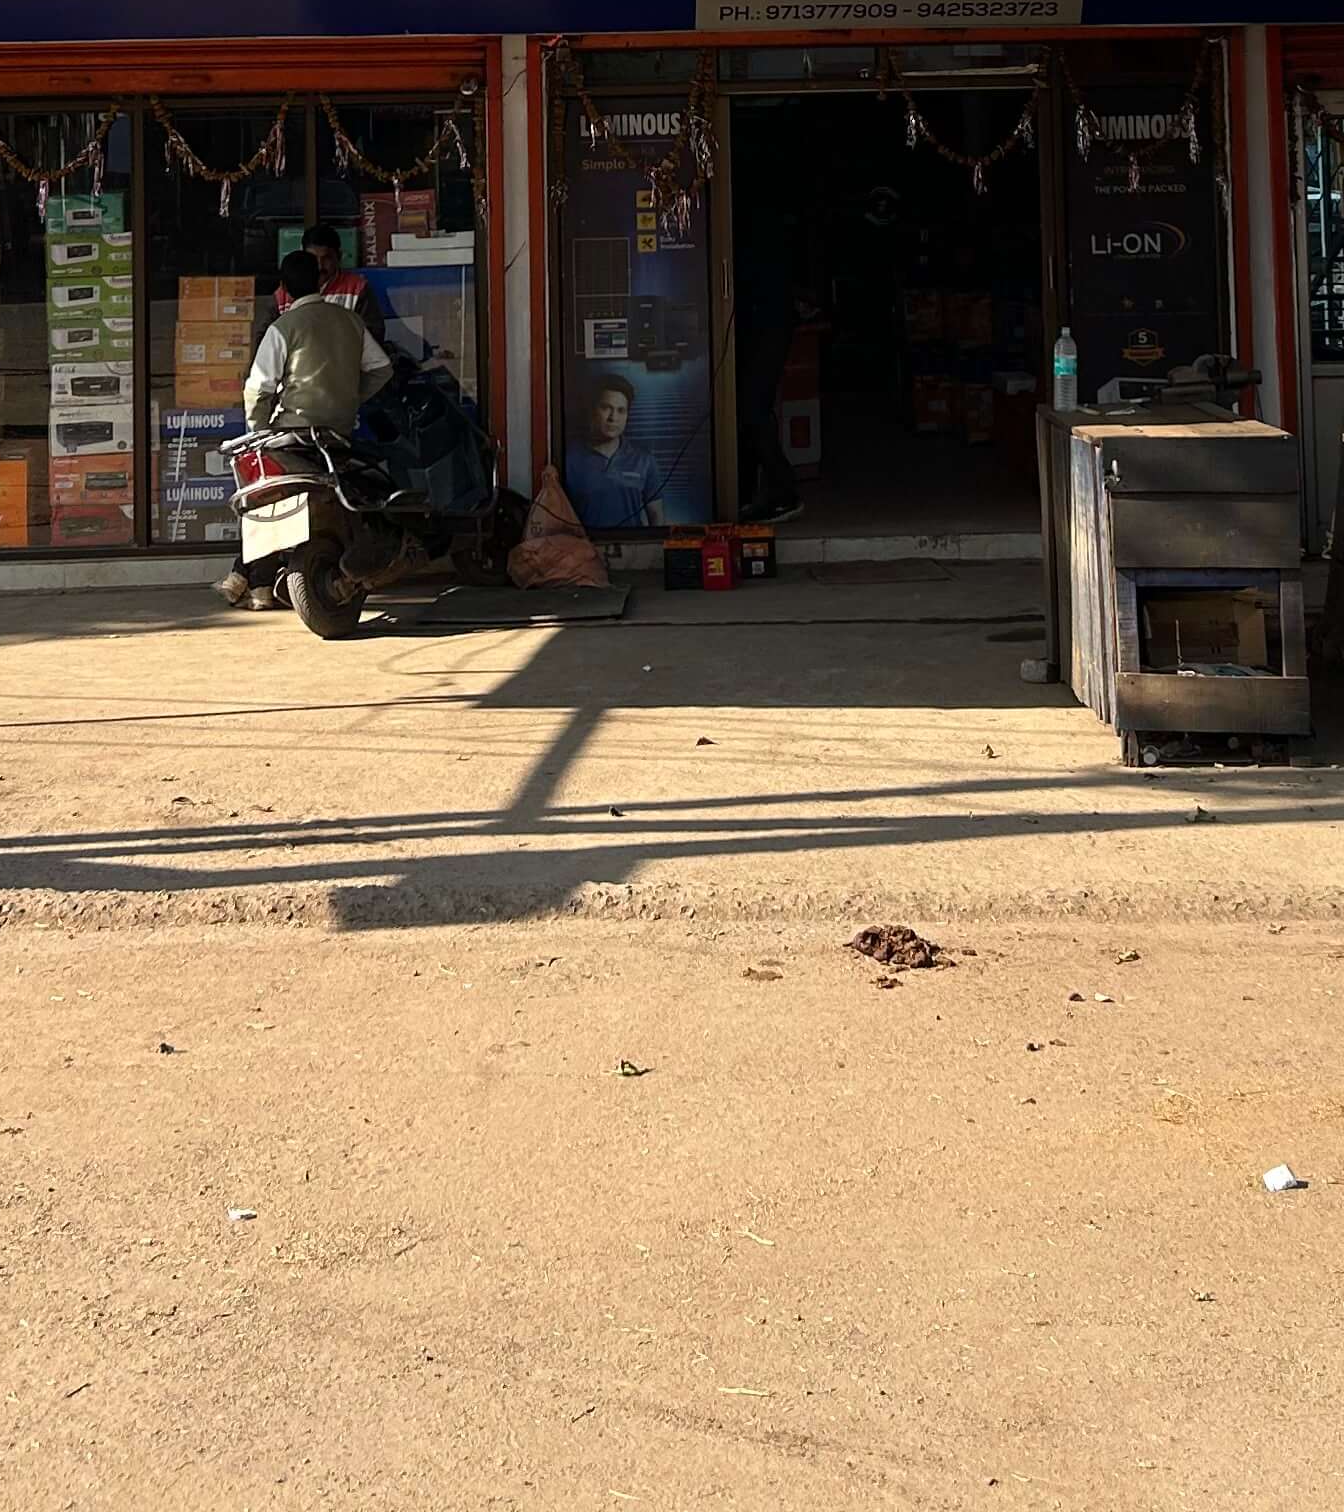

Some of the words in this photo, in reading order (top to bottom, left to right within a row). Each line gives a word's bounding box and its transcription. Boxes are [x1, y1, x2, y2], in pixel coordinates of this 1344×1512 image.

[766, 3, 898, 21] 9713777909
[917, 1, 1059, 18] 9425323723
[1090, 232, 1162, 256] Li-ON
[166, 413, 226, 429] LUMINOUS
[166, 486, 225, 502] LUMINOUS
